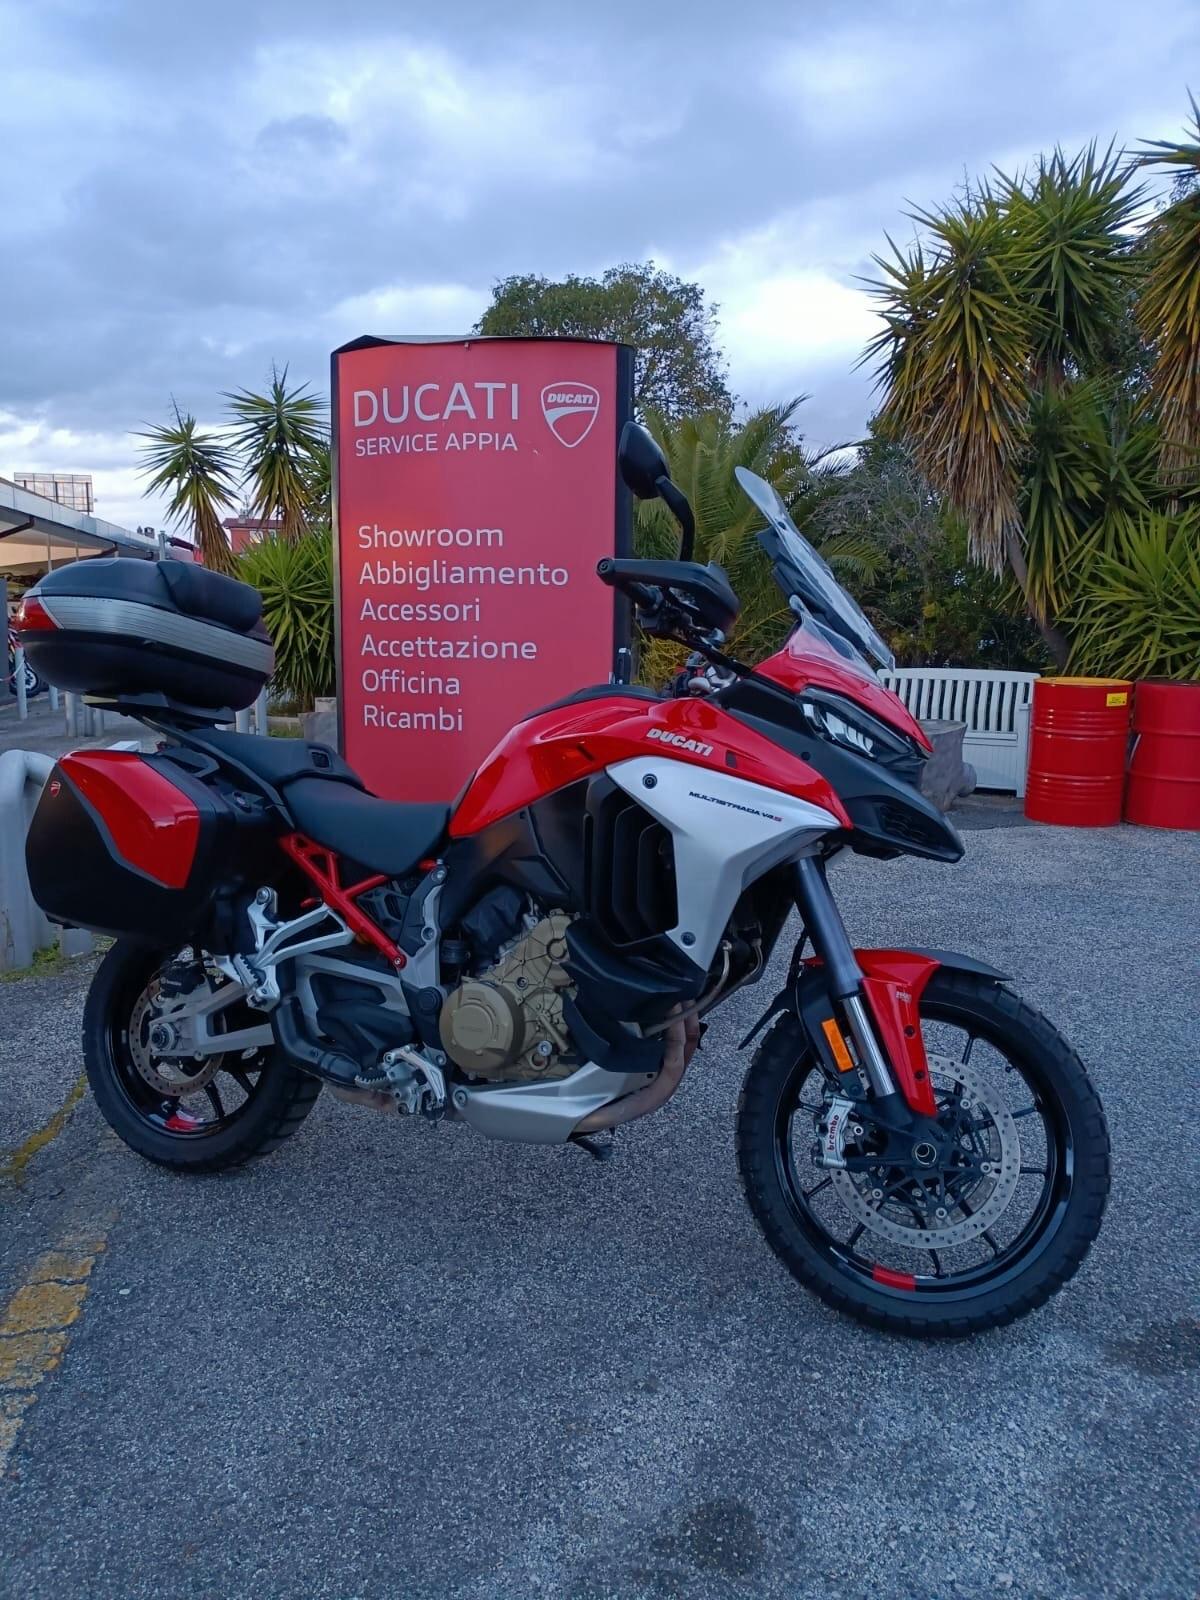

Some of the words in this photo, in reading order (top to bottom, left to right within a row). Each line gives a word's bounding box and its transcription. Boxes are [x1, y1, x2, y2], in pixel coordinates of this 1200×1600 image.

[353, 382, 519, 427] DUCATI
[547, 392, 594, 404] DUCATI
[355, 433, 438, 457] SERVICE
[445, 432, 518, 451] APPIA
[358, 524, 504, 549] Showroom
[359, 560, 569, 591] Abbigliamento
[360, 598, 480, 622] Accessori
[361, 634, 538, 660] Accettazione
[362, 669, 460, 695] Officina
[363, 704, 463, 731] Ricambi
[646, 728, 714, 757] DUCATI
[688, 791, 761, 816] MULTISTRADA
[827, 1114, 840, 1151] brembo
